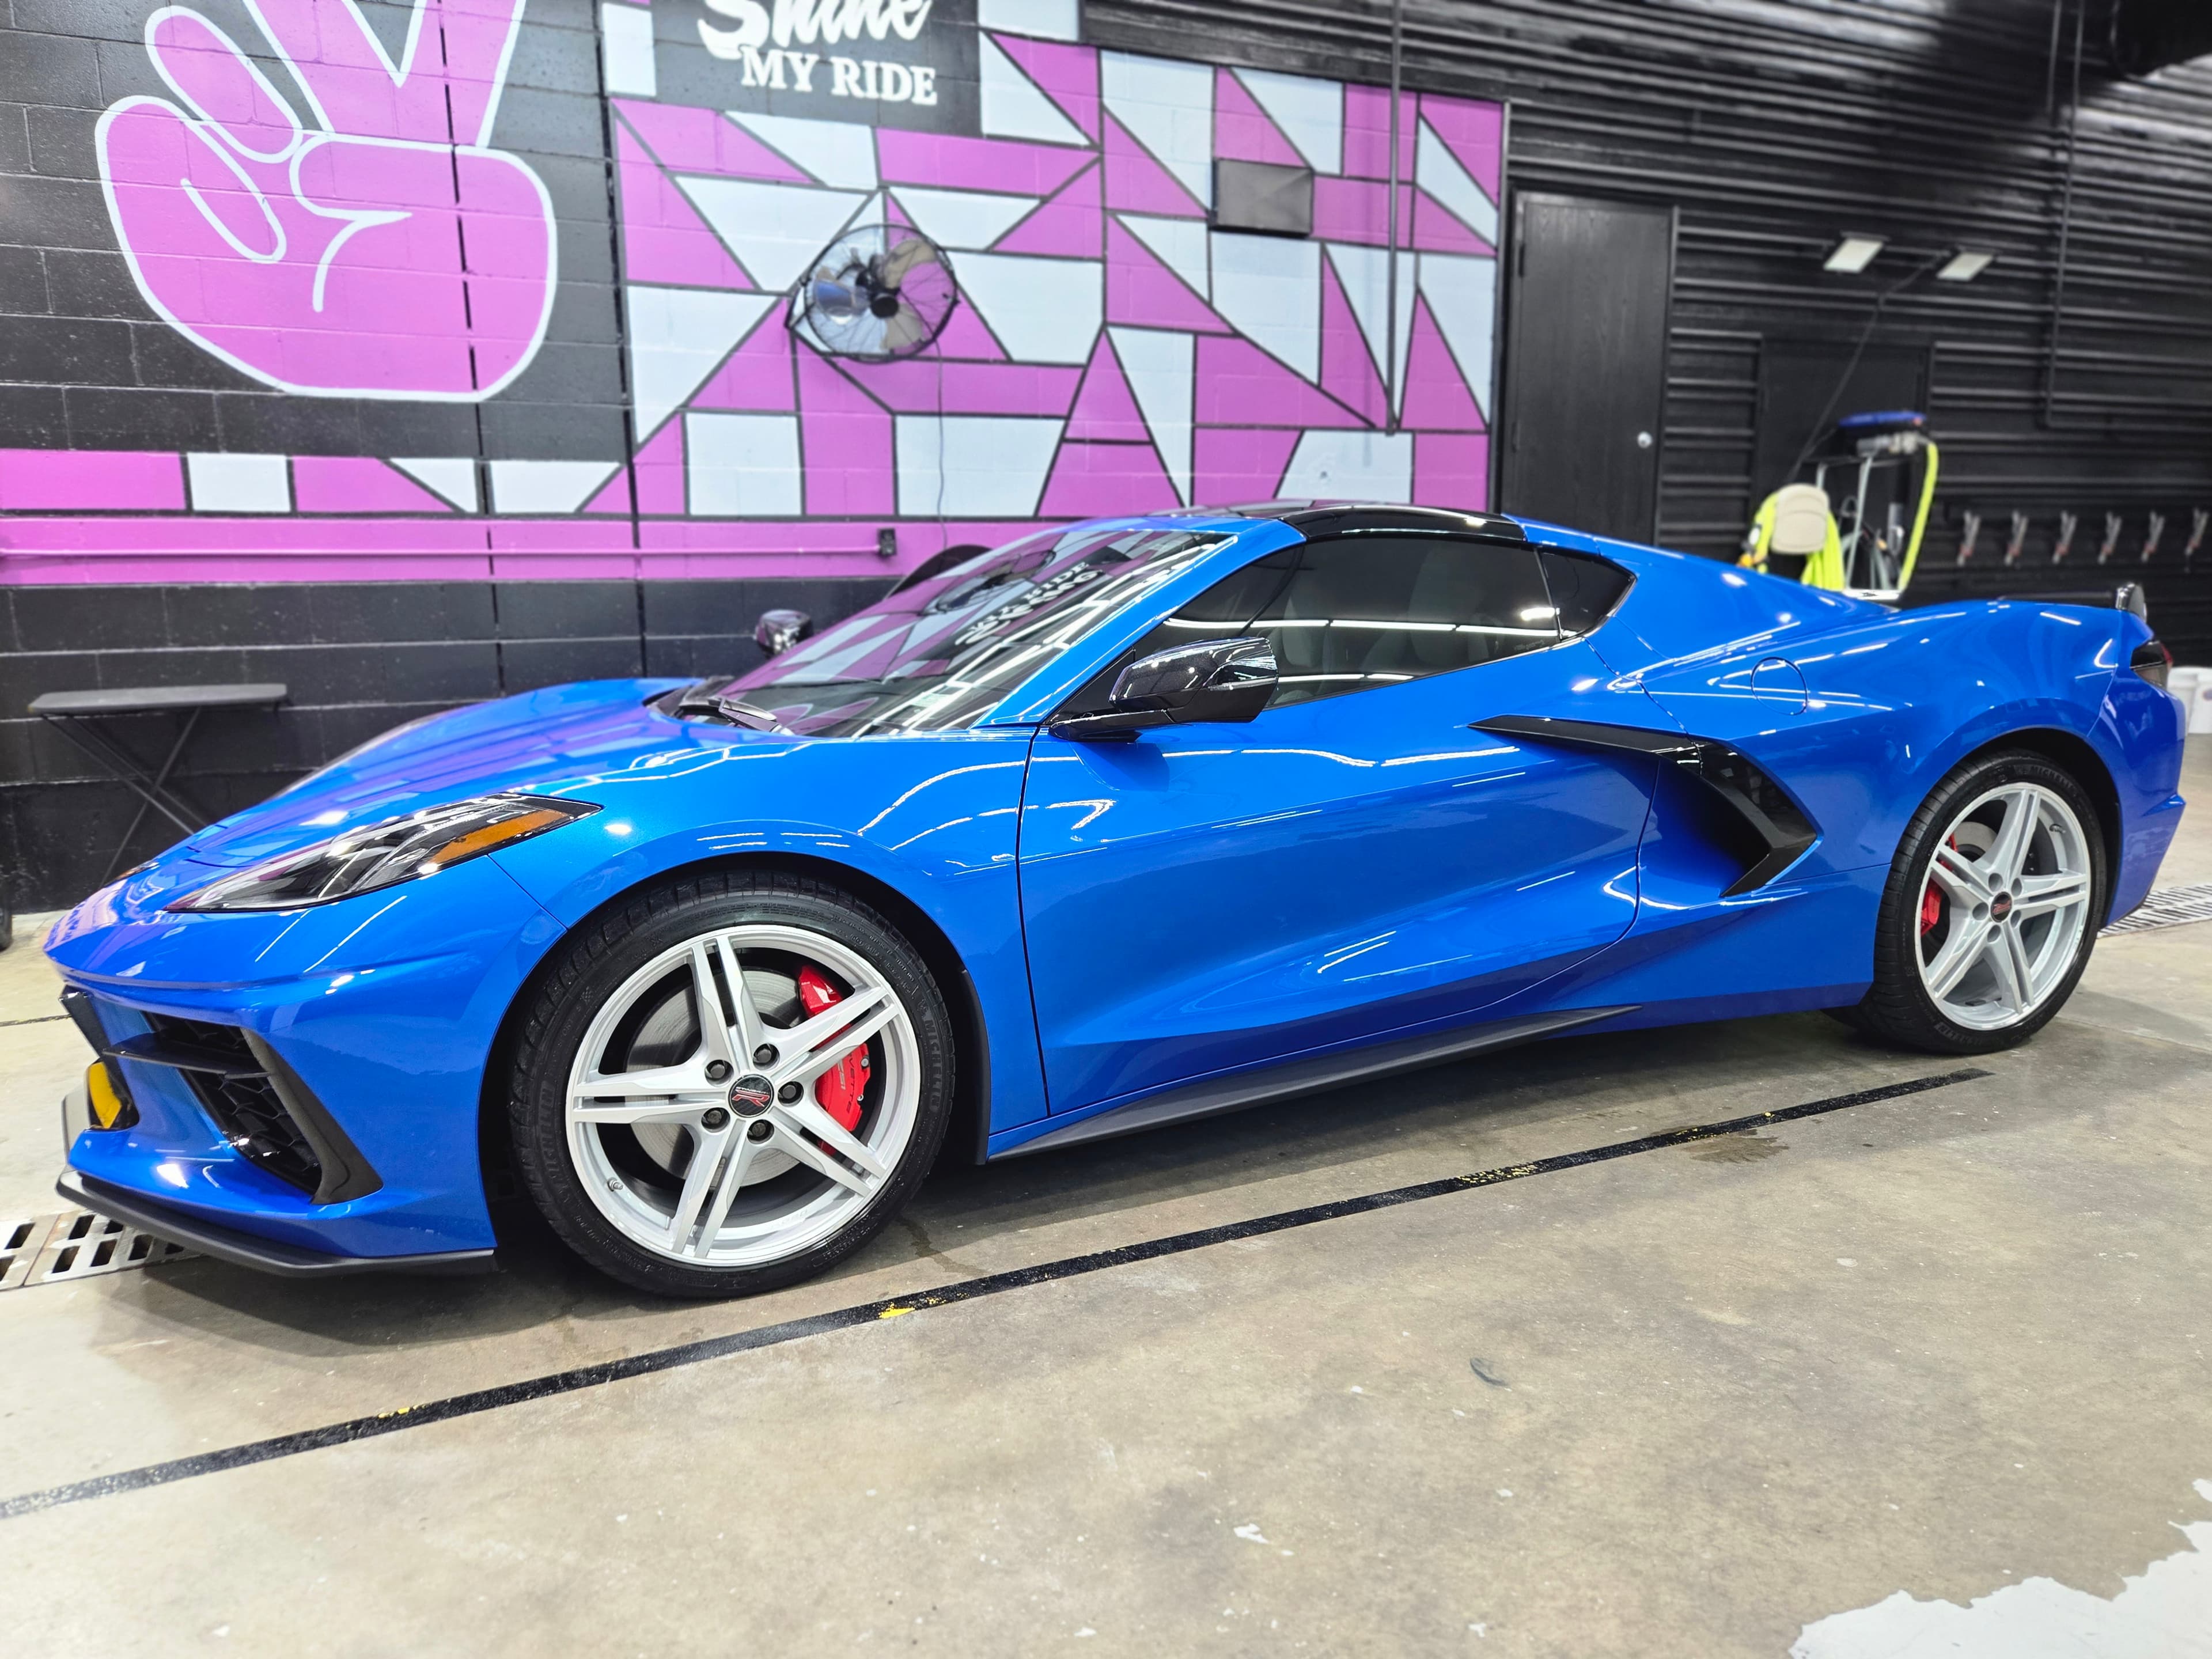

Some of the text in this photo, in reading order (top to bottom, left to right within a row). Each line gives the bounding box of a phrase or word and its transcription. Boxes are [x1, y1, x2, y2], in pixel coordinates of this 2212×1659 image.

[741, 46, 937, 105] MY RIDE
[925, 1019, 942, 1108] MICHELIN
